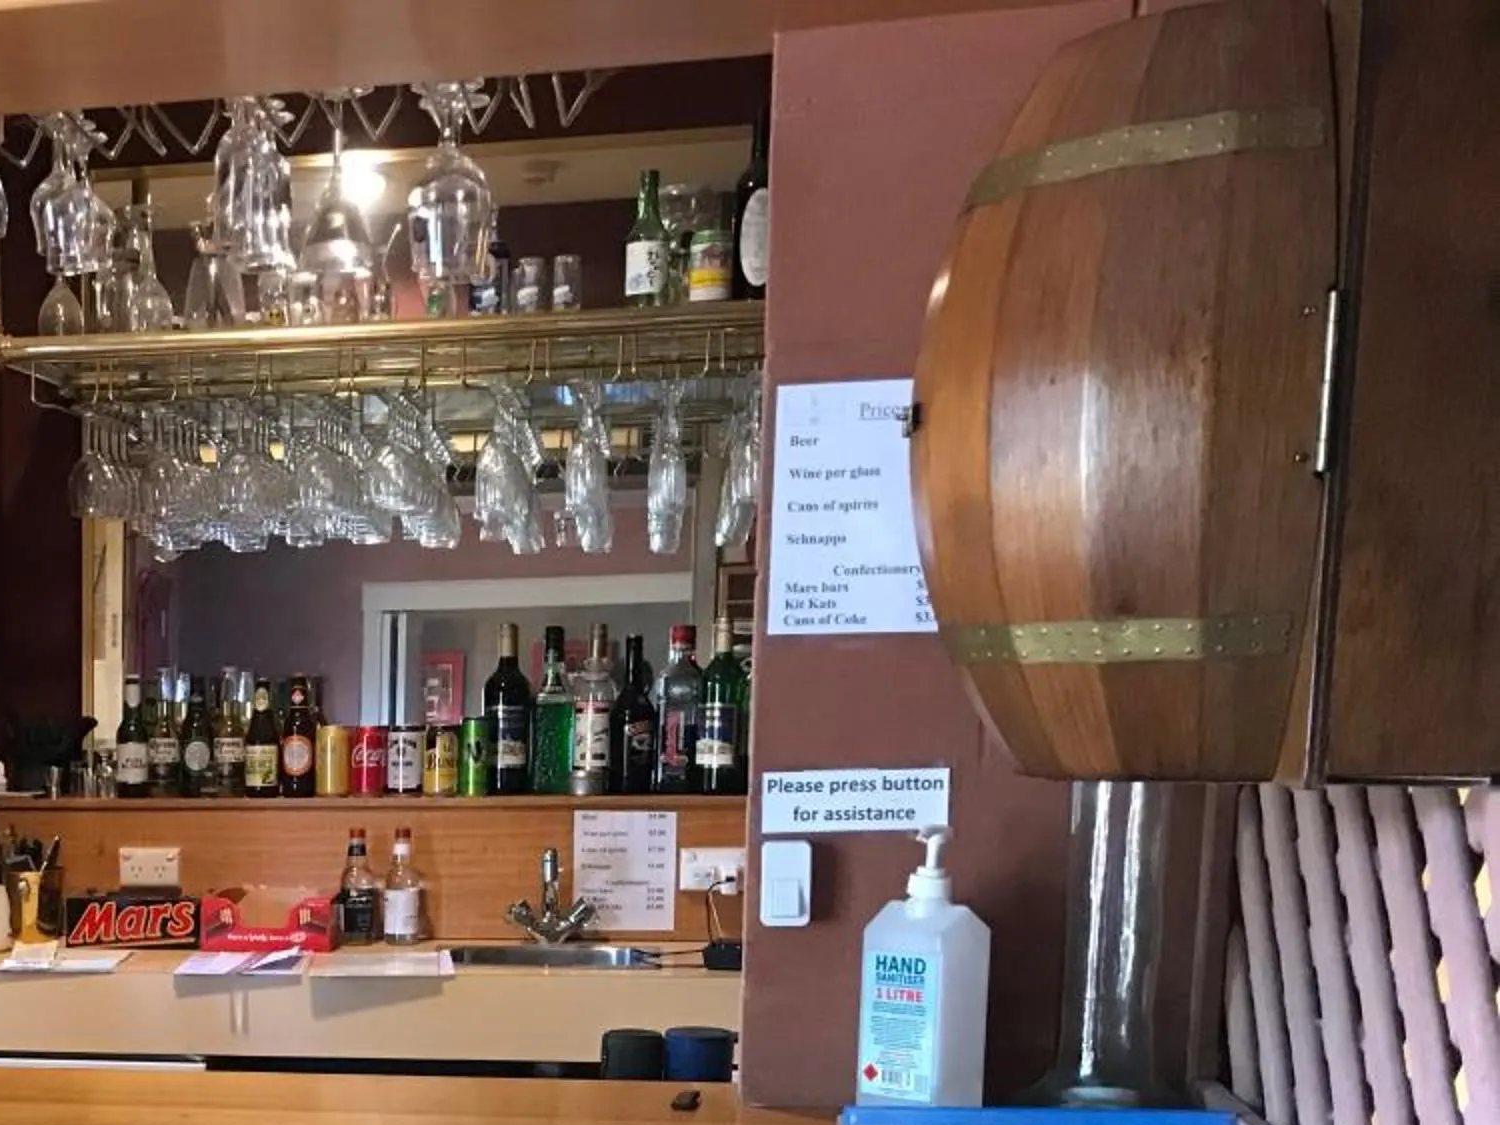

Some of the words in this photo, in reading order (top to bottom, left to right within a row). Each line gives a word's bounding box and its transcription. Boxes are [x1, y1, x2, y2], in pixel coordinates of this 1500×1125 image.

[789, 434, 820, 447] Beer
[788, 467, 822, 479] Wine
[825, 468, 846, 481] per
[850, 466, 881, 481] glass
[787, 501, 819, 513] Cans
[823, 500, 836, 511] of
[838, 499, 879, 514] spirits
[786, 532, 847, 547] Schnapps
[784, 597, 805, 610] Kit
[808, 597, 837, 610] Kats
[783, 614, 815, 627] Cans
[818, 613, 833, 626] of
[834, 613, 867, 626] Coke
[766, 777, 825, 794] Please
[829, 778, 877, 796] press
[881, 775, 945, 792] button
[793, 806, 818, 822] for
[823, 806, 916, 822] assistance
[68, 900, 196, 946] Mars
[875, 954, 927, 975] HAND
[875, 971, 926, 985] SANITISER
[886, 988, 924, 1003] LITRE
